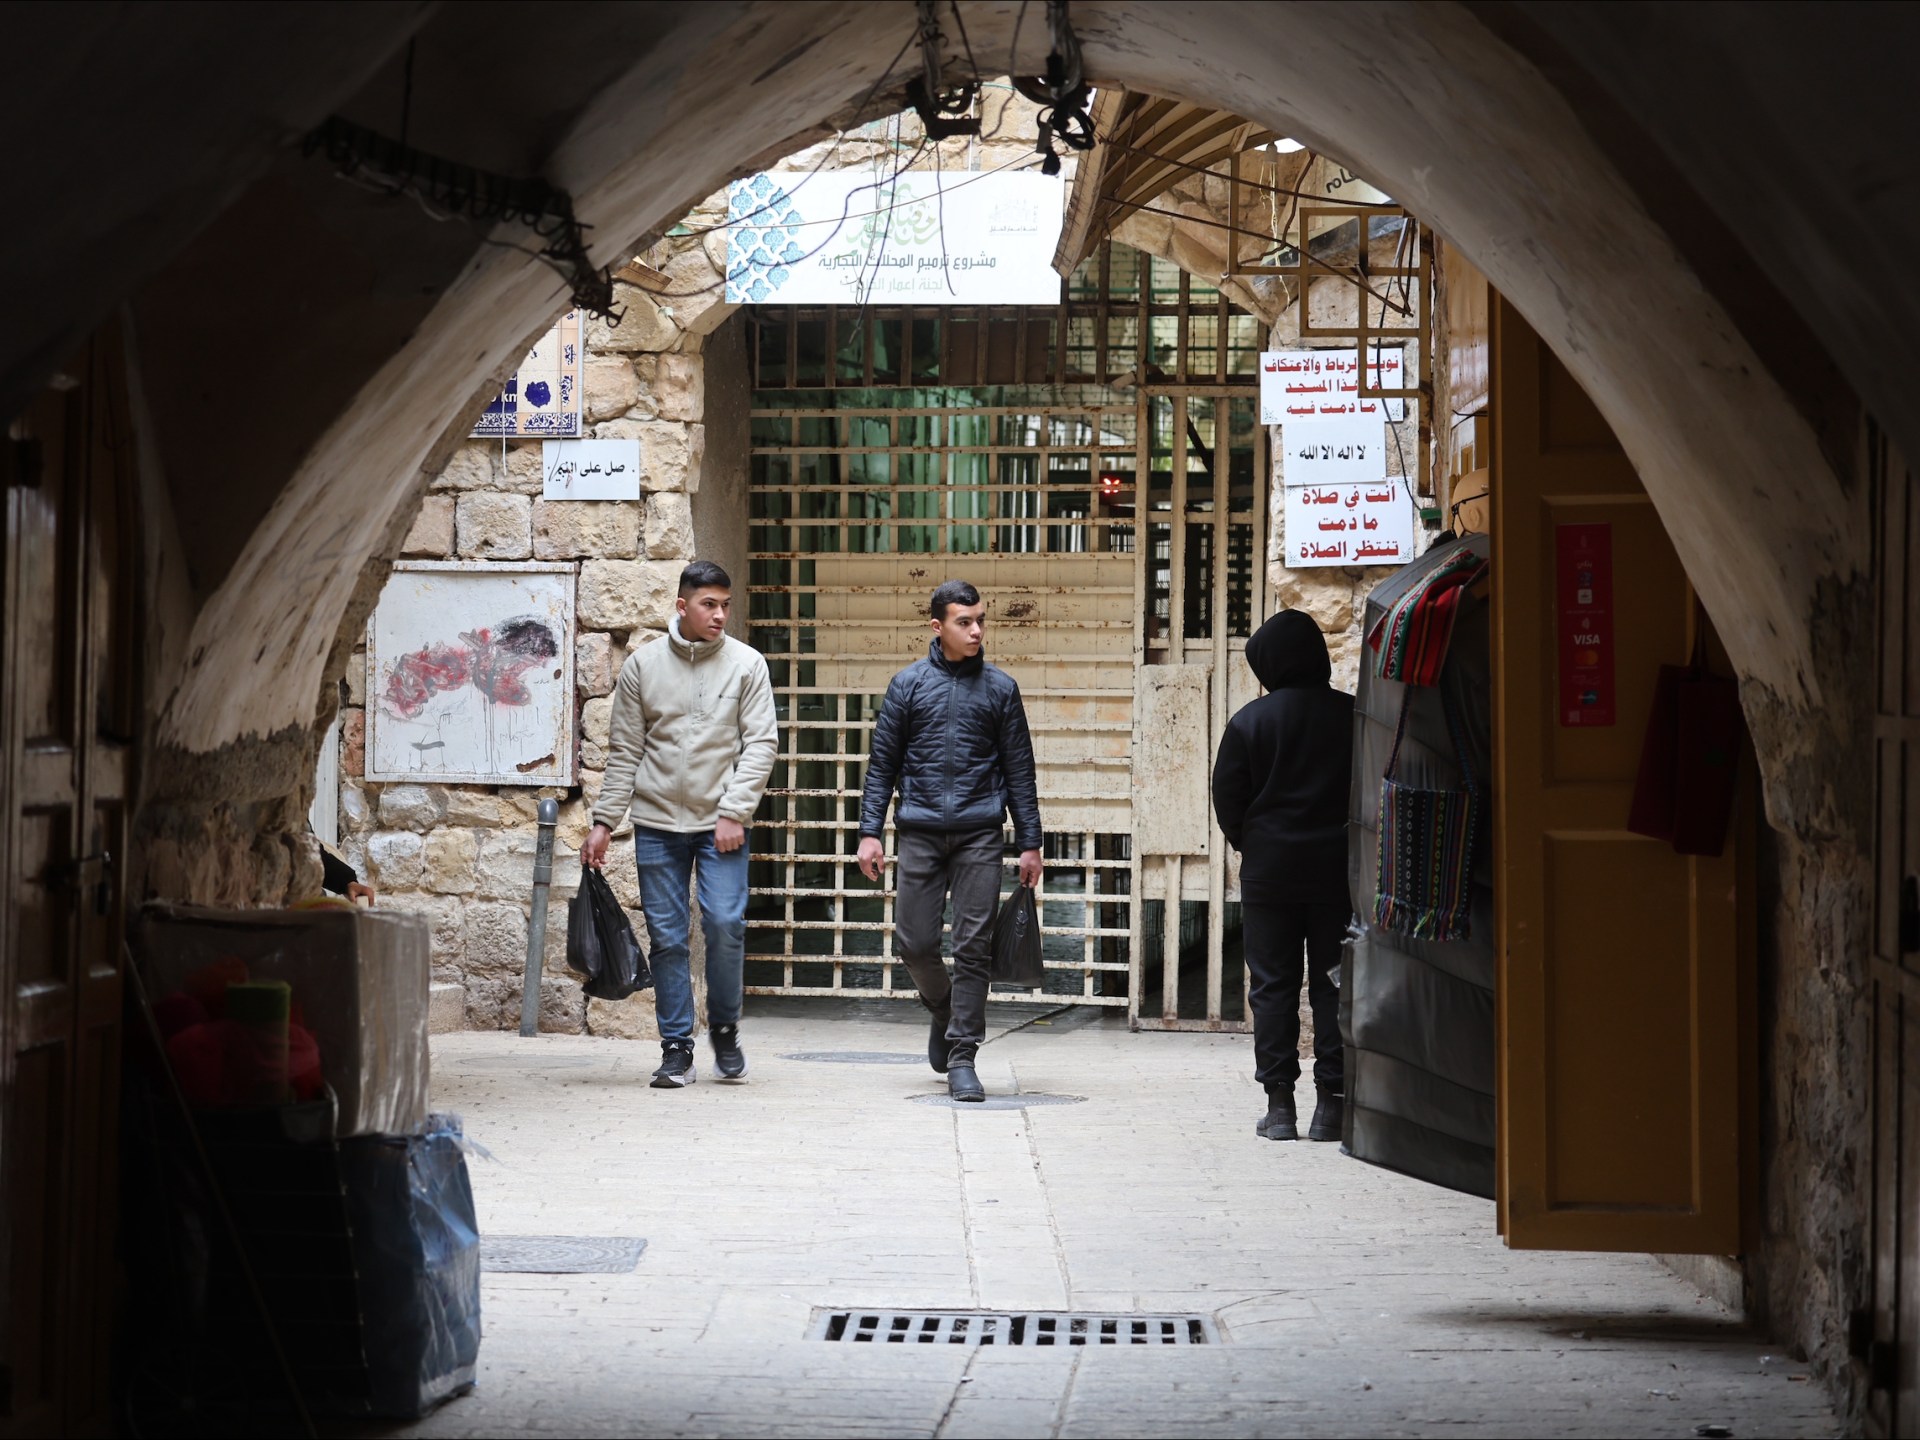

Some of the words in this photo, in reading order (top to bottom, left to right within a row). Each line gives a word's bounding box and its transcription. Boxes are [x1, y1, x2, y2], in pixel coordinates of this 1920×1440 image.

[917, 253, 950, 273] ترميم
[952, 250, 996, 270] مشروع
[919, 277, 943, 291] لجنة
[1326, 356, 1357, 374] لرباط
[1285, 379, 1332, 396] المسجد
[1287, 402, 1315, 418] فيه
[1320, 402, 1355, 414] دمت
[1360, 400, 1376, 413] ما
[1299, 446, 1318, 460] الله
[579, 461, 602, 477] على
[604, 460, 626, 477] صل
[1302, 485, 1338, 505] صلاة
[1344, 485, 1360, 511] في
[1318, 516, 1357, 531] دمت
[1363, 513, 1379, 531] ما
[1300, 542, 1347, 558] الصلاة
[1351, 540, 1399, 561] تنتظر
[1573, 634, 1600, 645] VISA
